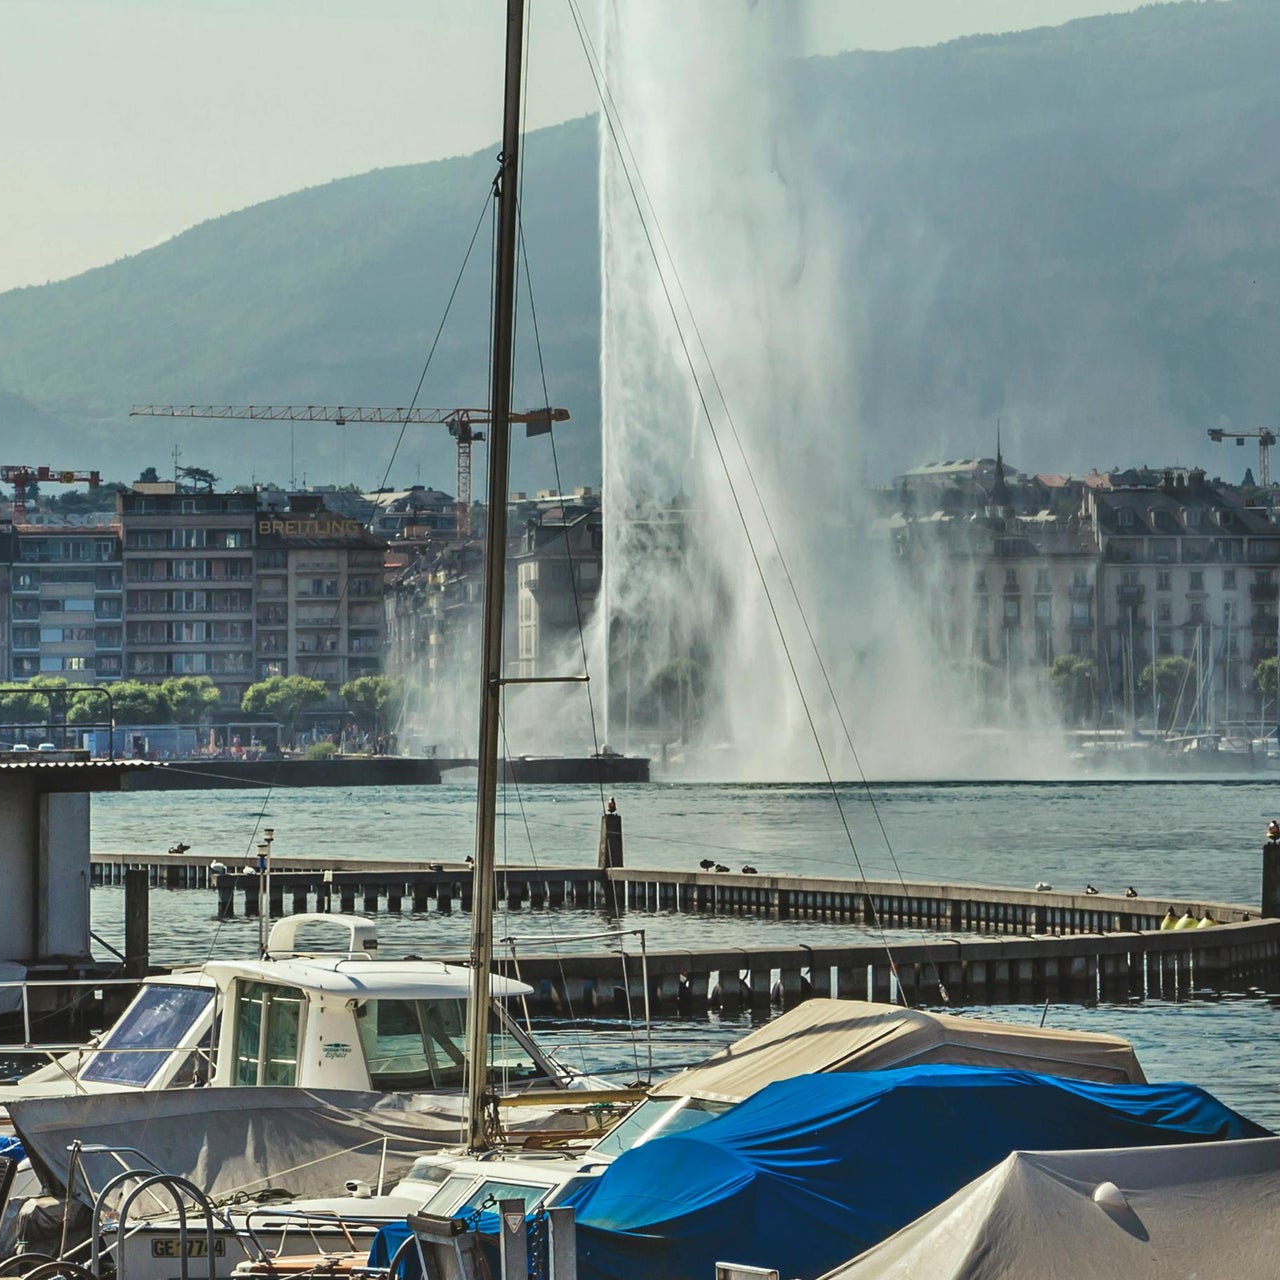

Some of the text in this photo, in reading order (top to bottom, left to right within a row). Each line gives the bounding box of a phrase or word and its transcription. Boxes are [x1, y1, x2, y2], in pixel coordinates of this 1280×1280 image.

[27, 512, 117, 528] TISSOT
[259, 520, 358, 535] BREITLING
[154, 1241, 173, 1256] GE
